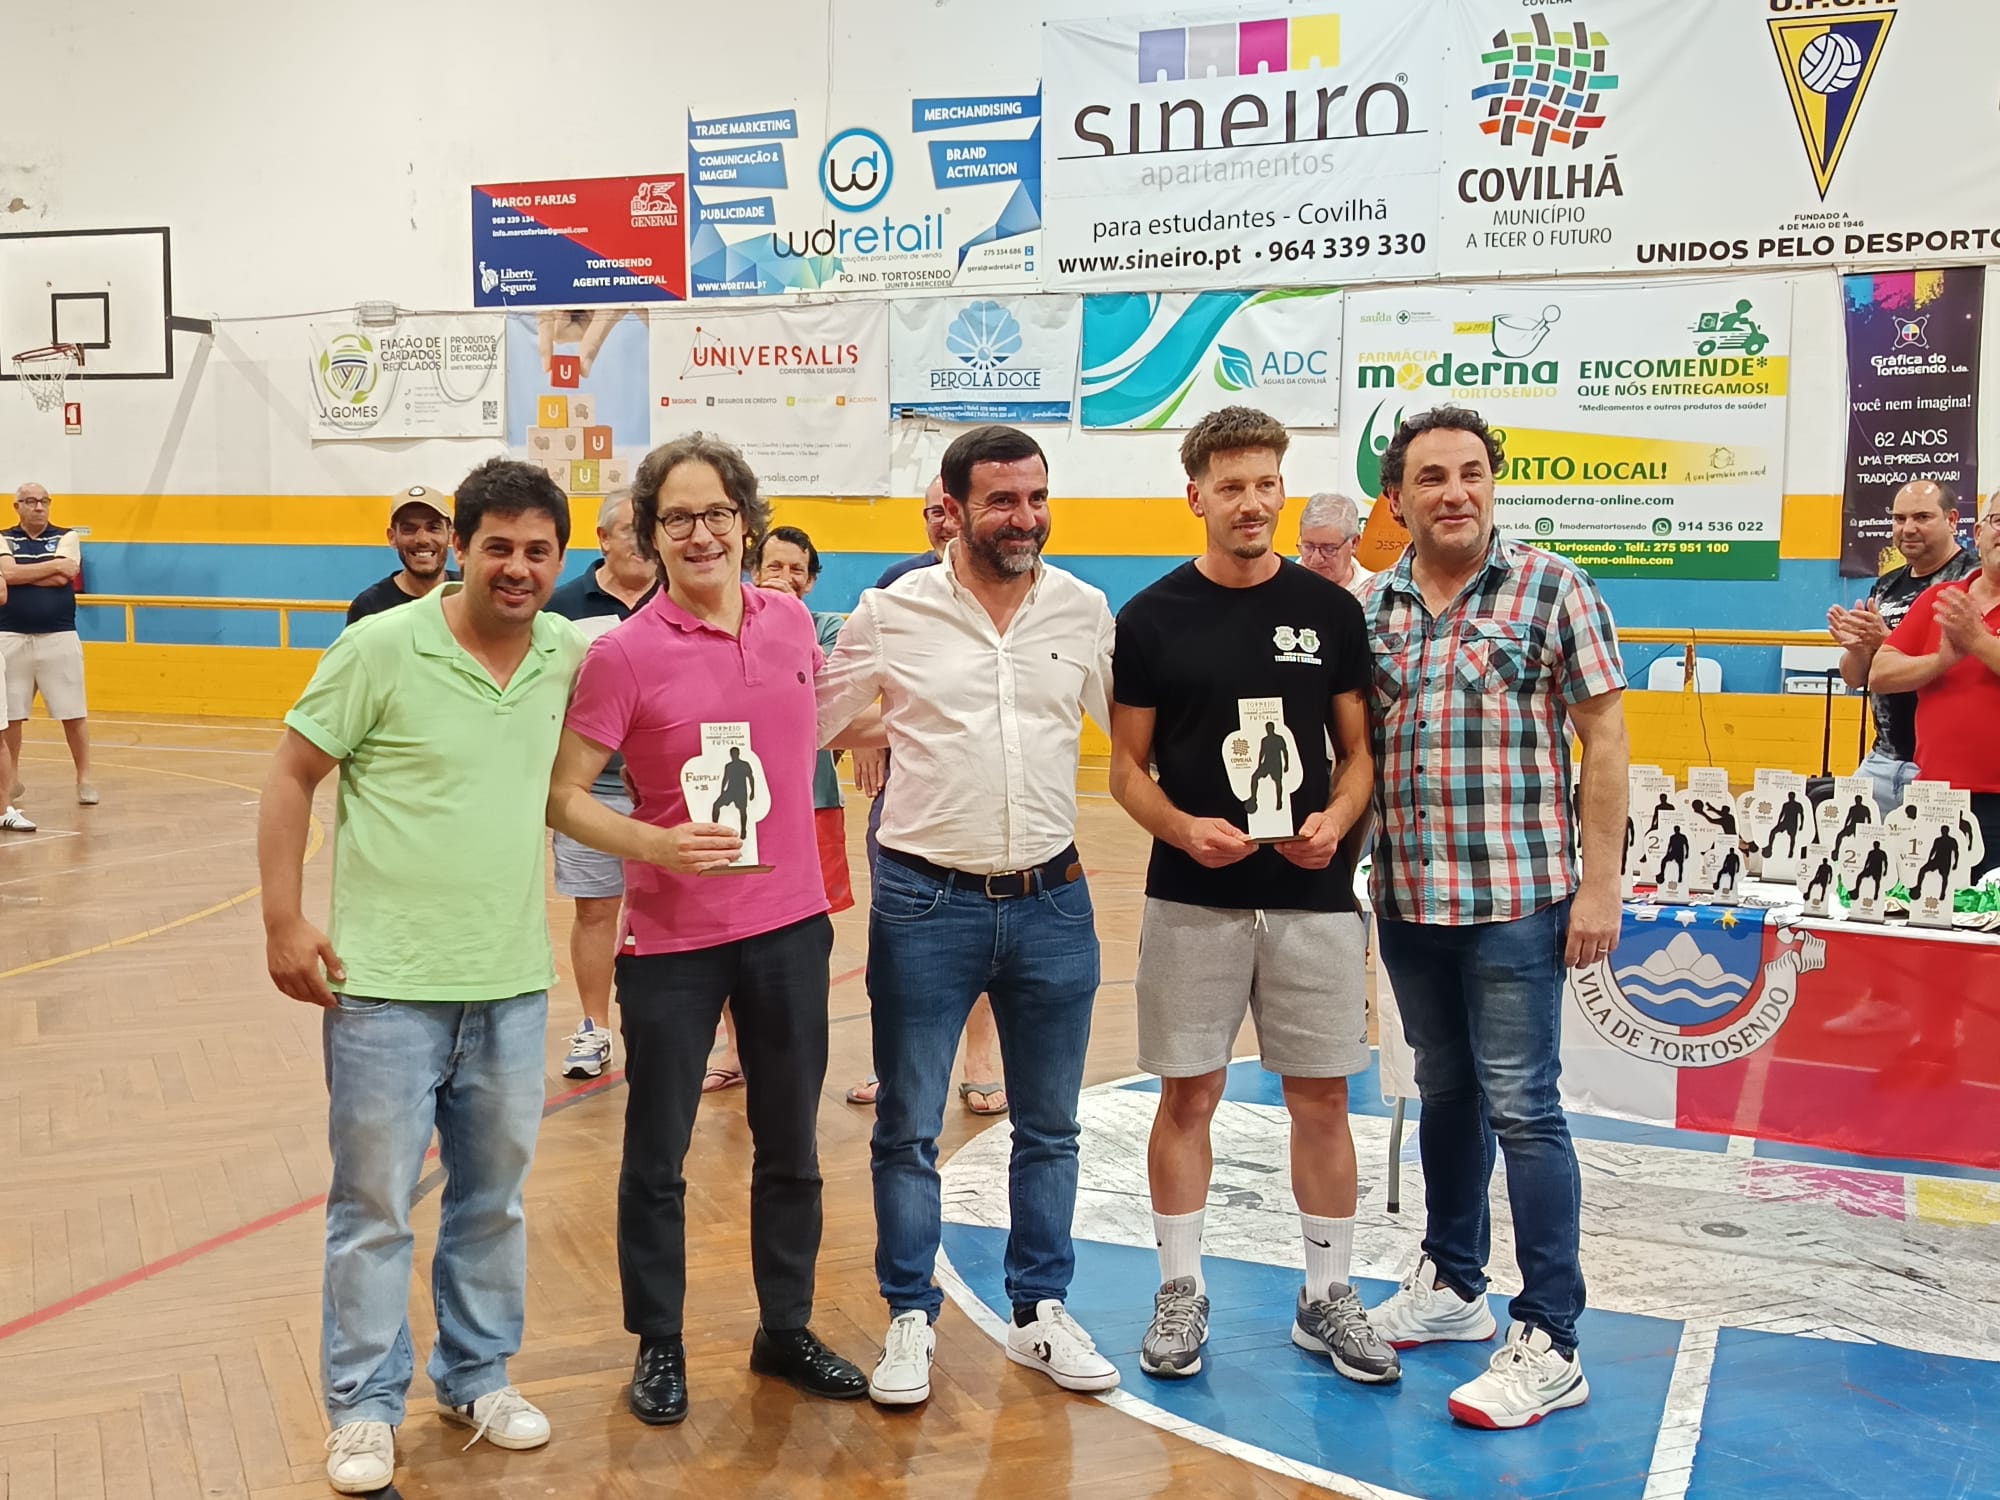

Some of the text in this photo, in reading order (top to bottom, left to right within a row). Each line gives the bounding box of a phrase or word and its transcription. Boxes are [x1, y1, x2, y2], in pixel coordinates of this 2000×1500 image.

[925, 102, 1022, 121] MERCHANDISING
[1074, 82, 1410, 155] sineiro
[696, 119, 791, 137] TRADE MARKETING
[699, 151, 779, 167] COMUNICAÇÃO &
[947, 147, 986, 160] BRAND
[699, 169, 737, 181] IMAGEM
[947, 162, 1018, 179] ACTIVATION
[1141, 152, 1335, 190] apartamentos
[1458, 154, 1624, 203] COVILHÃ
[492, 193, 577, 208] MARCO FARIAS
[701, 206, 765, 220] PUBLICIDADE
[1493, 204, 1585, 226] MUNICÍPIO
[1794, 211, 1849, 222] FUNDADO A
[631, 214, 678, 228] GENERALI
[1094, 217, 1141, 243] para
[1149, 208, 1275, 236] estudantes
[1298, 199, 1388, 225] Covilhã
[1778, 219, 1865, 231] 4 DE MAIO DE 1946
[773, 213, 943, 258] wdretail
[1466, 227, 1612, 248] A TECER O FUTURO
[1059, 233, 1426, 273] www.sineiro.pt 964 339 330
[1637, 239, 1749, 265] UNIDOS
[1758, 236, 1835, 259] PELO
[586, 257, 653, 269] TORTOSENDO
[500, 268, 535, 280] Liberty
[573, 275, 668, 288] AGENTE PRINCIPAL
[840, 269, 951, 284] PQ. IND. TORTOSENDO
[500, 283, 537, 296] Seguros
[697, 281, 767, 292] WWW.WDRETAIL.PT
[381, 335, 441, 350] FIAÇÃO DE
[451, 336, 496, 344] PRODUTOS
[381, 350, 442, 362] CARDADOS
[451, 345, 462, 353] DE
[464, 344, 489, 353] MODA
[693, 345, 859, 367] UNIVERSALIS
[1358, 348, 1439, 363] FARMÁCIA
[1261, 351, 1327, 375] ADC
[1871, 352, 1946, 367] Gráfica do
[998, 371, 1040, 387] DOCE
[1263, 376, 1327, 385] ÁGUAS DA COVILHÃ
[1451, 386, 1558, 399] TORTOSENDO
[1577, 381, 1769, 397] QUE NÓS ENTREGAMOS!
[1653, 403, 1682, 411] outros
[1683, 402, 1723, 413] produtos
[1725, 402, 1736, 410] de
[1853, 394, 1971, 412] você nem imagina!
[331, 406, 378, 418] GOMES
[1875, 429, 1948, 447] 62 ANOS
[1858, 452, 1959, 466] UMA EMPRESA COM
[1583, 461, 1667, 480] LOCAL!
[1857, 472, 1907, 486] TRADIÇÃO
[1494, 494, 1674, 506] maciamoderna-online.com
[1560, 522, 1647, 531] fmodernatortosendo
[1678, 521, 1763, 532] 914 536 022
[1554, 542, 1729, 553] Tortosendo Telf.: 275 951 100
[1569, 555, 1674, 566] oderna-online.com
[1577, 971, 1789, 1063] VILA DE TORTOSENDO
